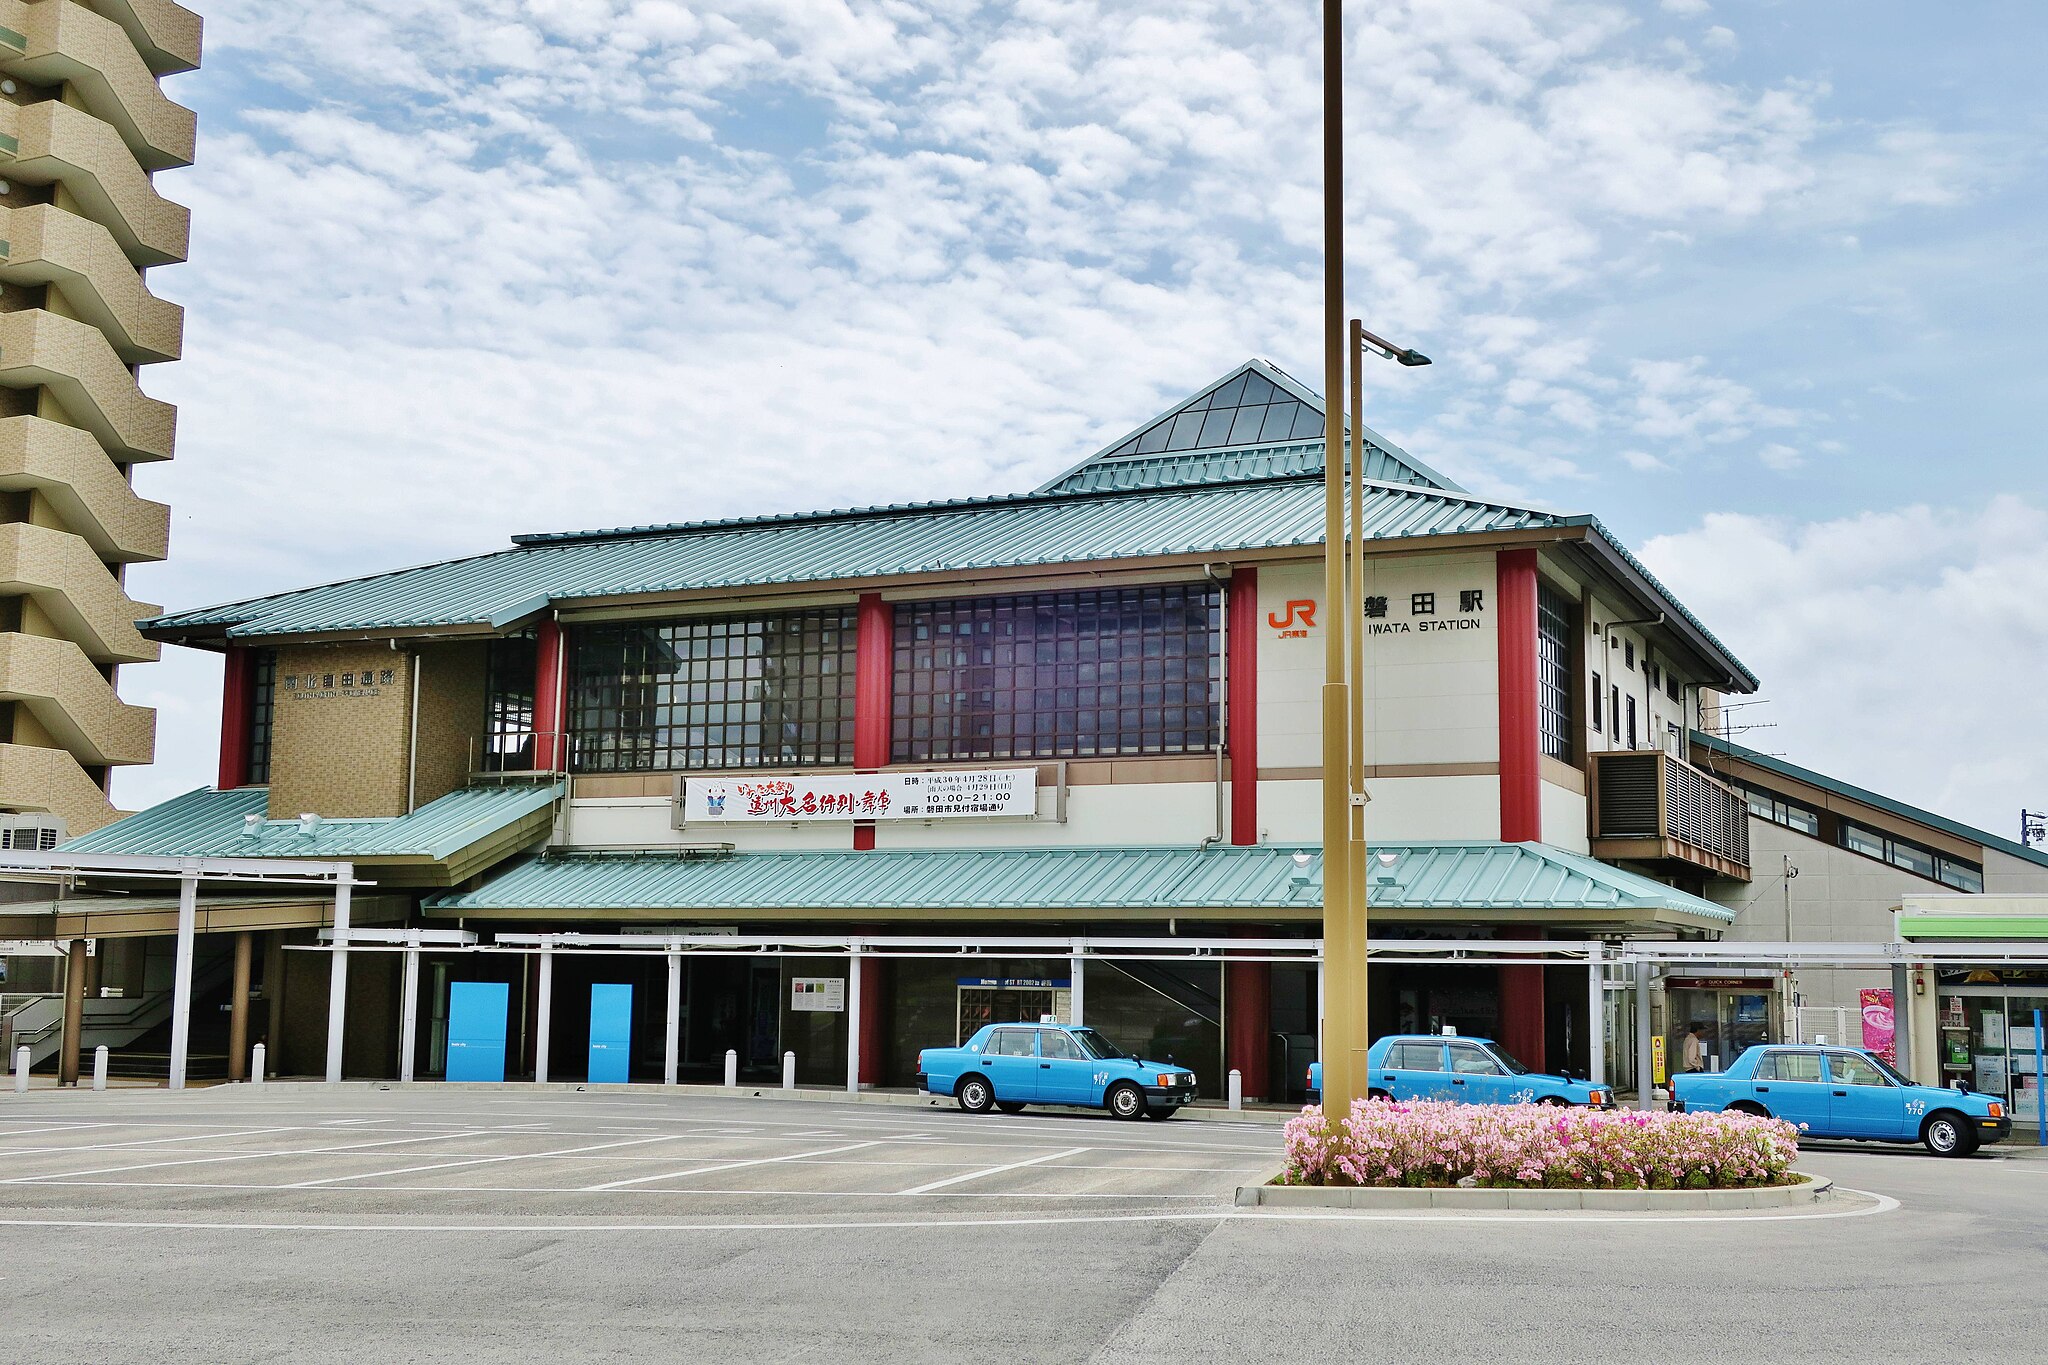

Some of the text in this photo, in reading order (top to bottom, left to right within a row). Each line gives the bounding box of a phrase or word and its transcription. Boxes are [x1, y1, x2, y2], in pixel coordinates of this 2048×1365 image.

[1268, 599, 1316, 629] JR
[1364, 590, 1483, 618] 磐田駅
[1368, 619, 1480, 635] IWATA STATION
